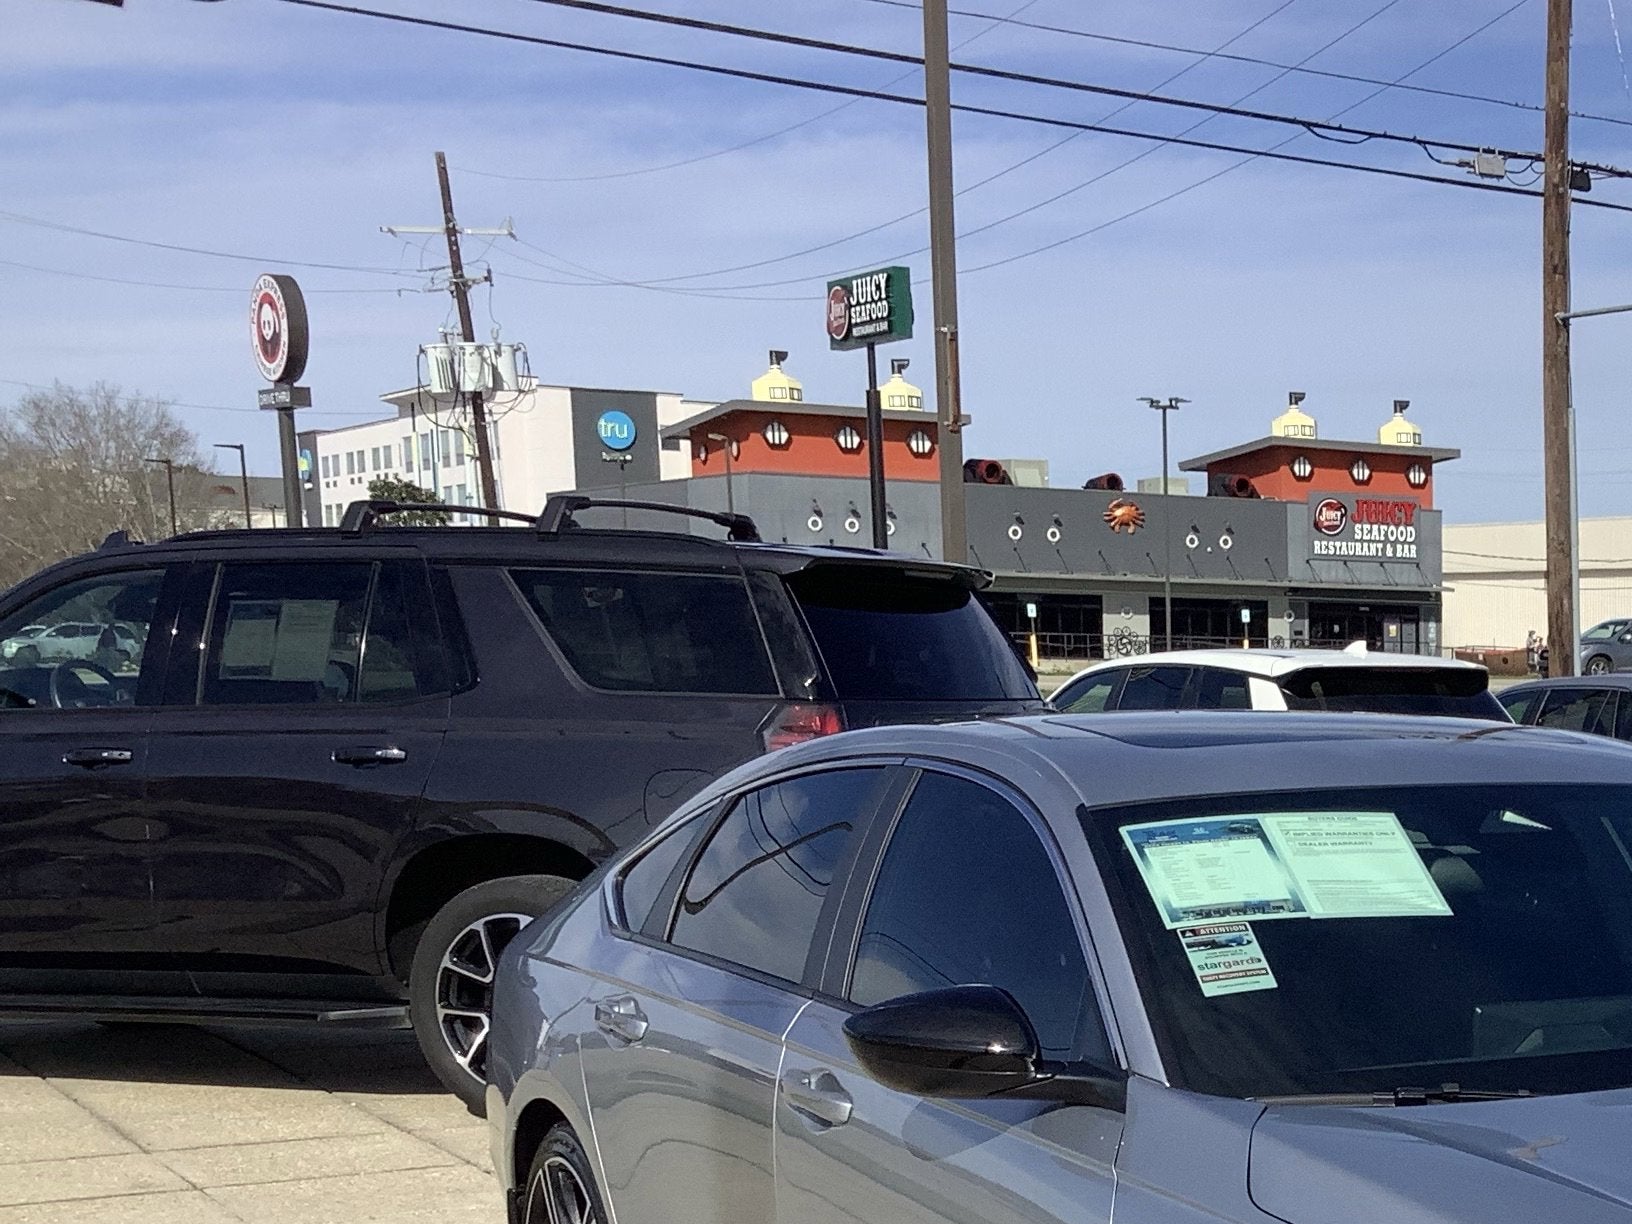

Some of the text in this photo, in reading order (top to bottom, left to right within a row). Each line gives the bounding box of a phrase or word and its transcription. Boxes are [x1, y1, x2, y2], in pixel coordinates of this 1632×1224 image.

[850, 272, 888, 306] JUICY
[850, 300, 889, 324] SEAFOOD
[599, 418, 628, 439] tru
[1351, 499, 1416, 526] JUICY
[1354, 523, 1416, 543] SEAFOOD
[1313, 540, 1417, 558] RESTAURANT & BAR
[1200, 925, 1246, 935] ATTENTION
